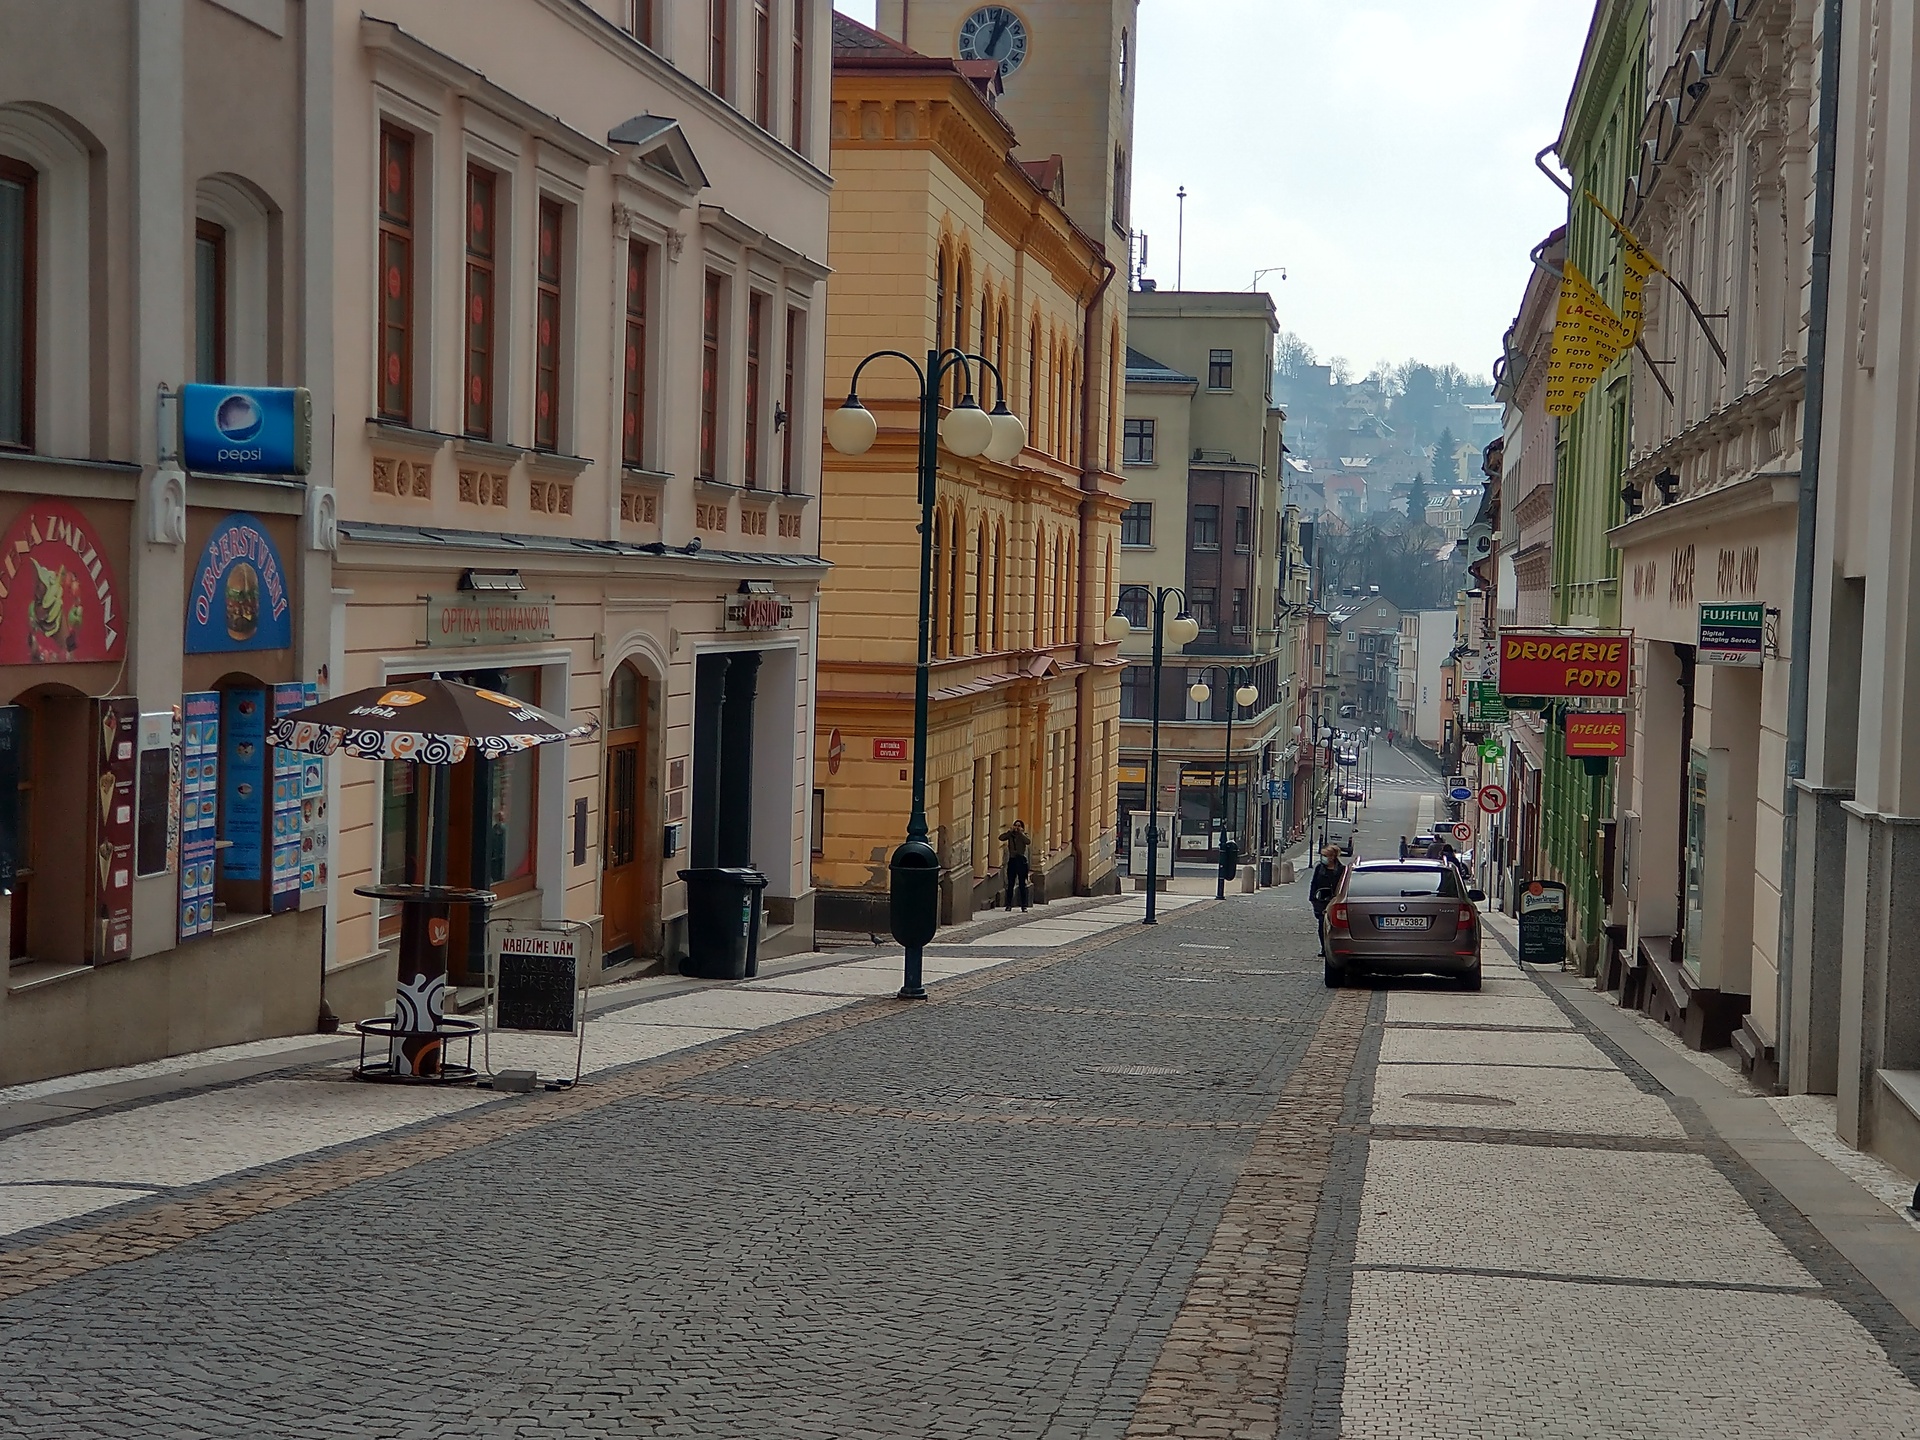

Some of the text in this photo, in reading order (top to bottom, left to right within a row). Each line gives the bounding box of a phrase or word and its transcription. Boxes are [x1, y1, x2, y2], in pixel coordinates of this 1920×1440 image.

[977, 14, 984, 23] 11
[965, 24, 976, 33] 10
[1013, 25, 1021, 34] 2
[963, 38, 970, 47] 9
[1017, 39, 1024, 48] 3
[1011, 53, 1020, 63] 4
[1001, 64, 1008, 73] 5
[1588, 325, 1610, 338] FOTO
[1563, 335, 1617, 353] FOTO FOTO
[1566, 348, 1591, 356] FOTO
[1569, 362, 1594, 370] FOTO
[1572, 376, 1597, 384] FOTO
[1549, 404, 1573, 412] FOTO
[217, 447, 262, 462] pepsi
[196, 526, 289, 625] OBČERSTVENÍ
[748, 600, 781, 627] CASINO
[1702, 609, 1759, 621] FUJIFILM
[442, 607, 481, 633] OPTIKA
[1702, 636, 1729, 644] Imaging
[1506, 640, 1622, 662] DROGERIE
[1565, 668, 1621, 687] FOTO
[349, 705, 397, 718] kofola
[1570, 721, 1621, 735] ATELIÉR
[1385, 918, 1424, 926] 5L7 5382
[503, 938, 573, 955] NABÍZÍME VÁM
